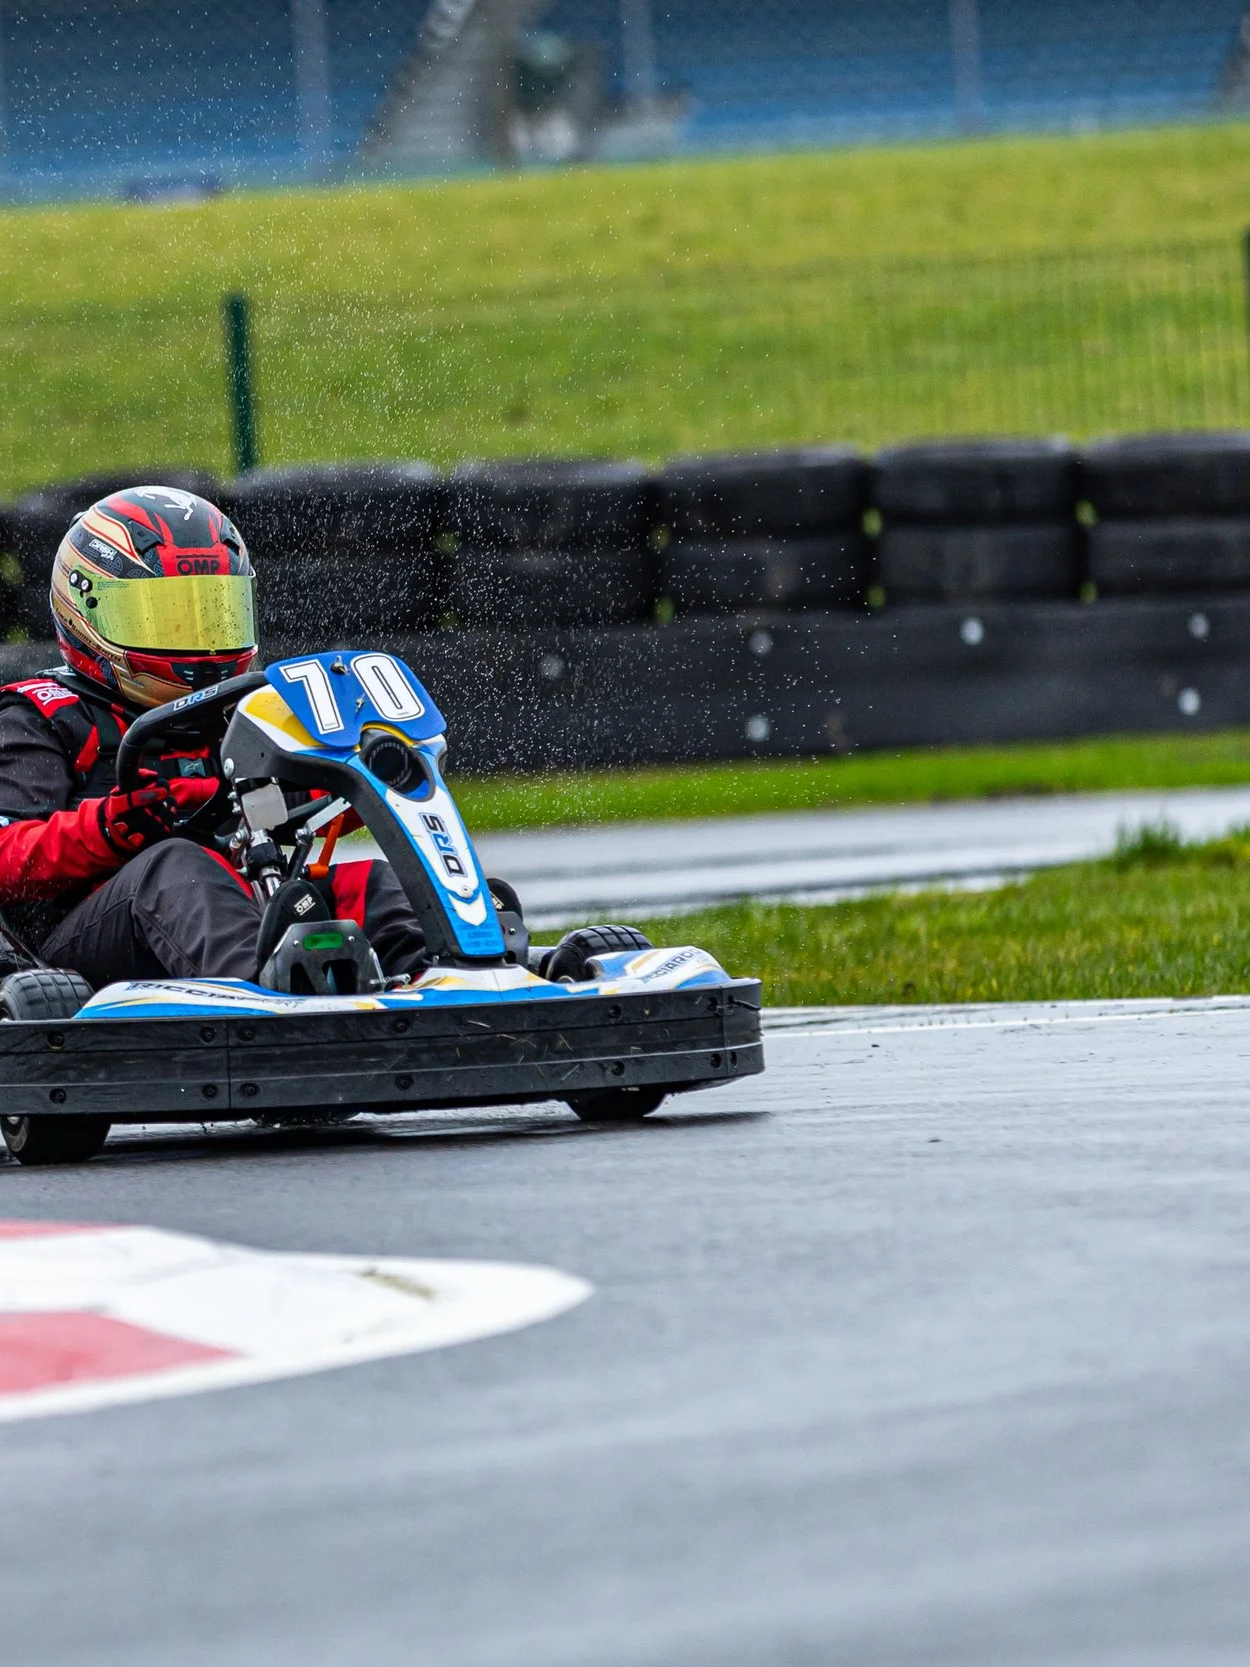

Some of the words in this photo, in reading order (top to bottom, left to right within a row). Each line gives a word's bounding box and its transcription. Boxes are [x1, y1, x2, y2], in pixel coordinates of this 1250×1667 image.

[177, 559, 220, 575] OMP
[174, 686, 218, 710] DRS
[279, 652, 425, 735] 10
[419, 813, 467, 877] DRS
[296, 896, 313, 913] OMP
